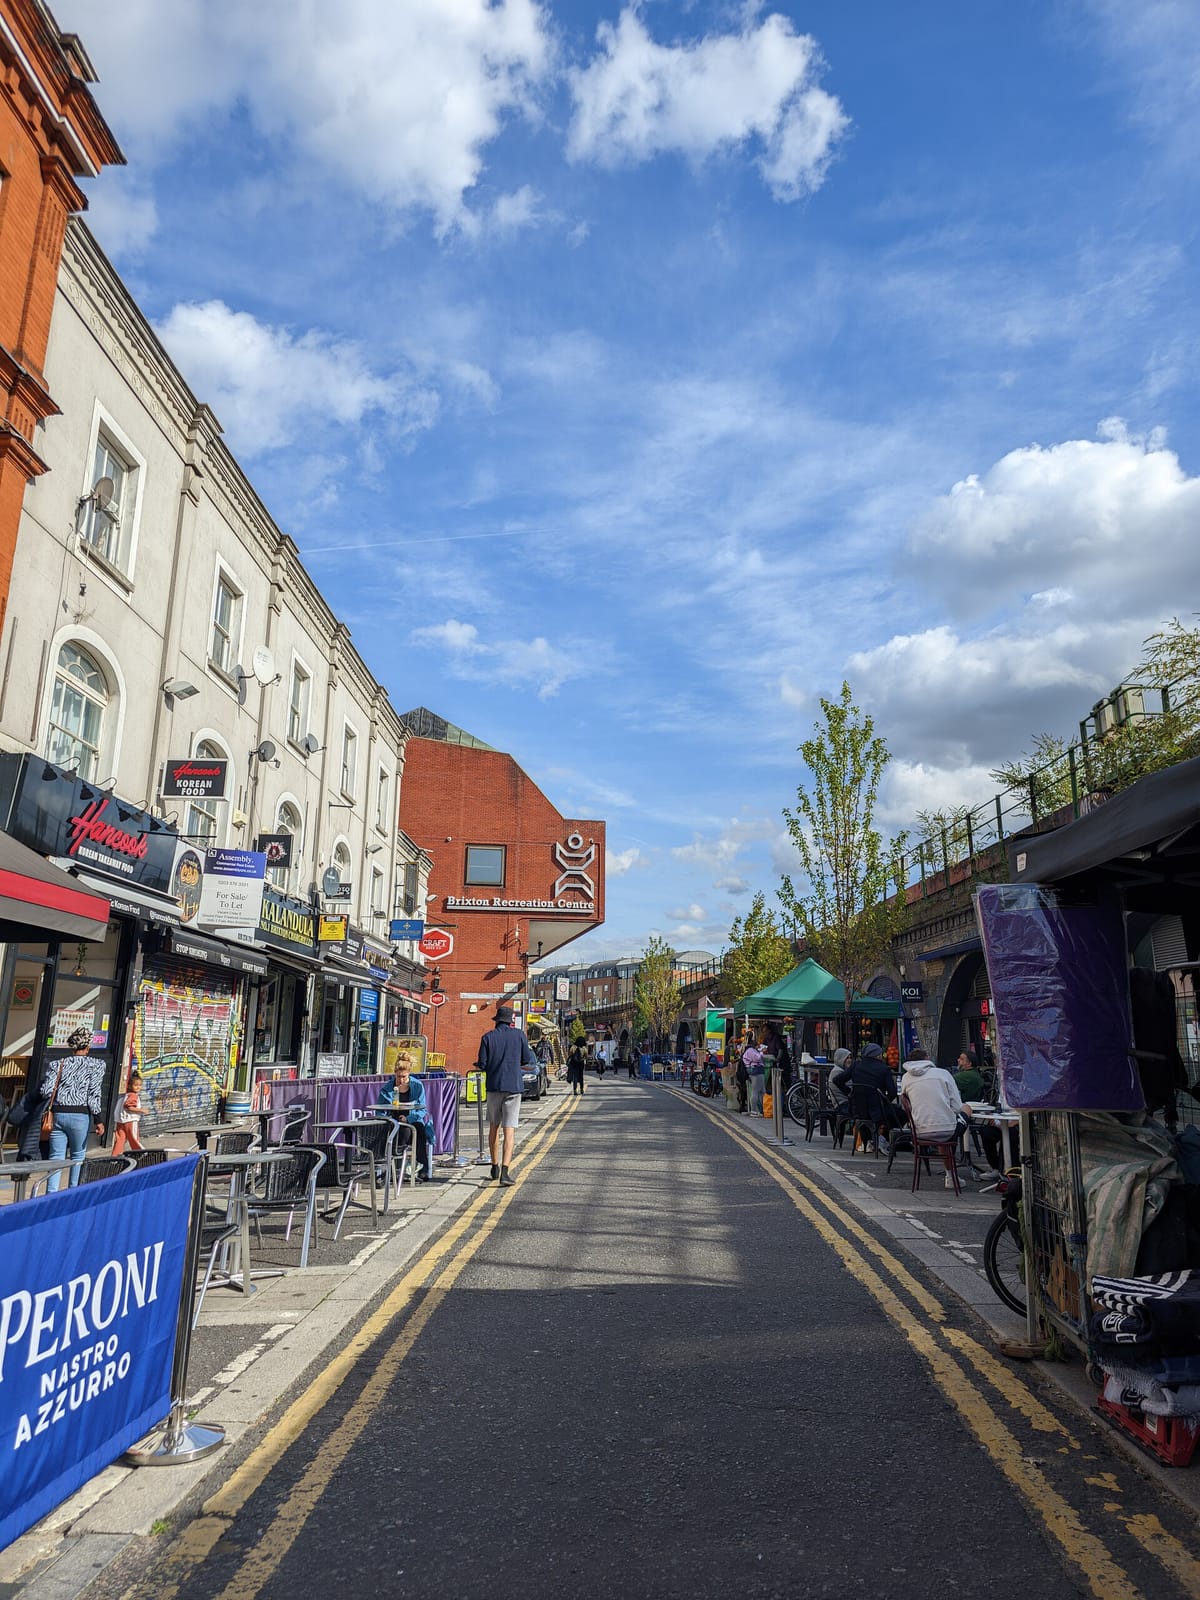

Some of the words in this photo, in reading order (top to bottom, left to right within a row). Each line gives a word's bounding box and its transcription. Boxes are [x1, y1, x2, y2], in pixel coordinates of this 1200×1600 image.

[176, 779, 212, 788] KOREAN
[181, 788, 205, 796] FOOD
[69, 799, 149, 858] Hancook
[78, 845, 98, 860] KOREAN
[121, 862, 134, 873] FOOD
[216, 891, 228, 899] For
[447, 896, 490, 906] Brixton
[492, 897, 555, 908] Recreation
[557, 899, 594, 909] Centre
[261, 898, 313, 938] KALANDULA
[175, 943, 189, 954] STOP
[902, 988, 919, 996] KOI
[0, 1241, 164, 1383] PERONI
[40, 1334, 119, 1398] NASTRO
[14, 1351, 131, 1450] AZZURRO
